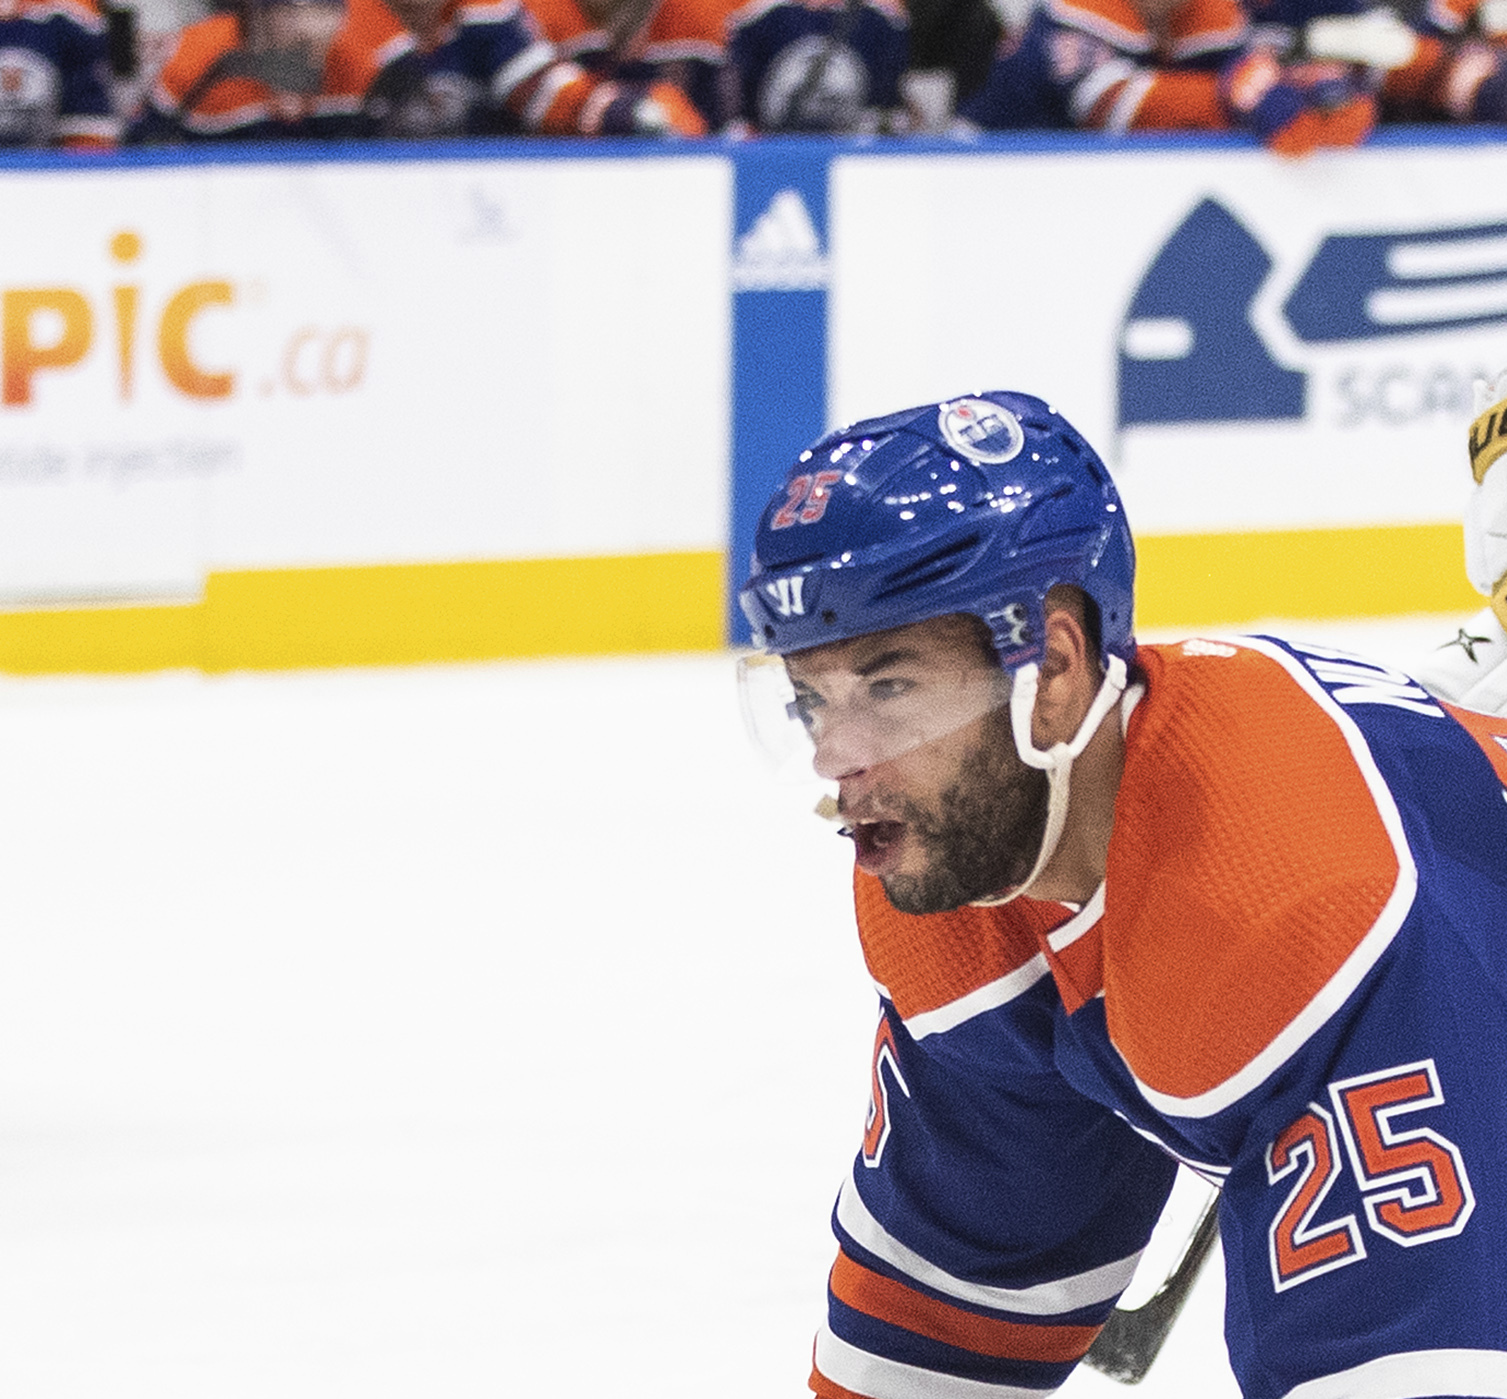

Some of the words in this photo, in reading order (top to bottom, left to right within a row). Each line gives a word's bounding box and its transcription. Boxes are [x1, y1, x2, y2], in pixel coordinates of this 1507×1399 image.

[1335, 362, 1488, 426] SCA
[770, 469, 842, 530] 25
[1265, 1058, 1477, 1294] 25
